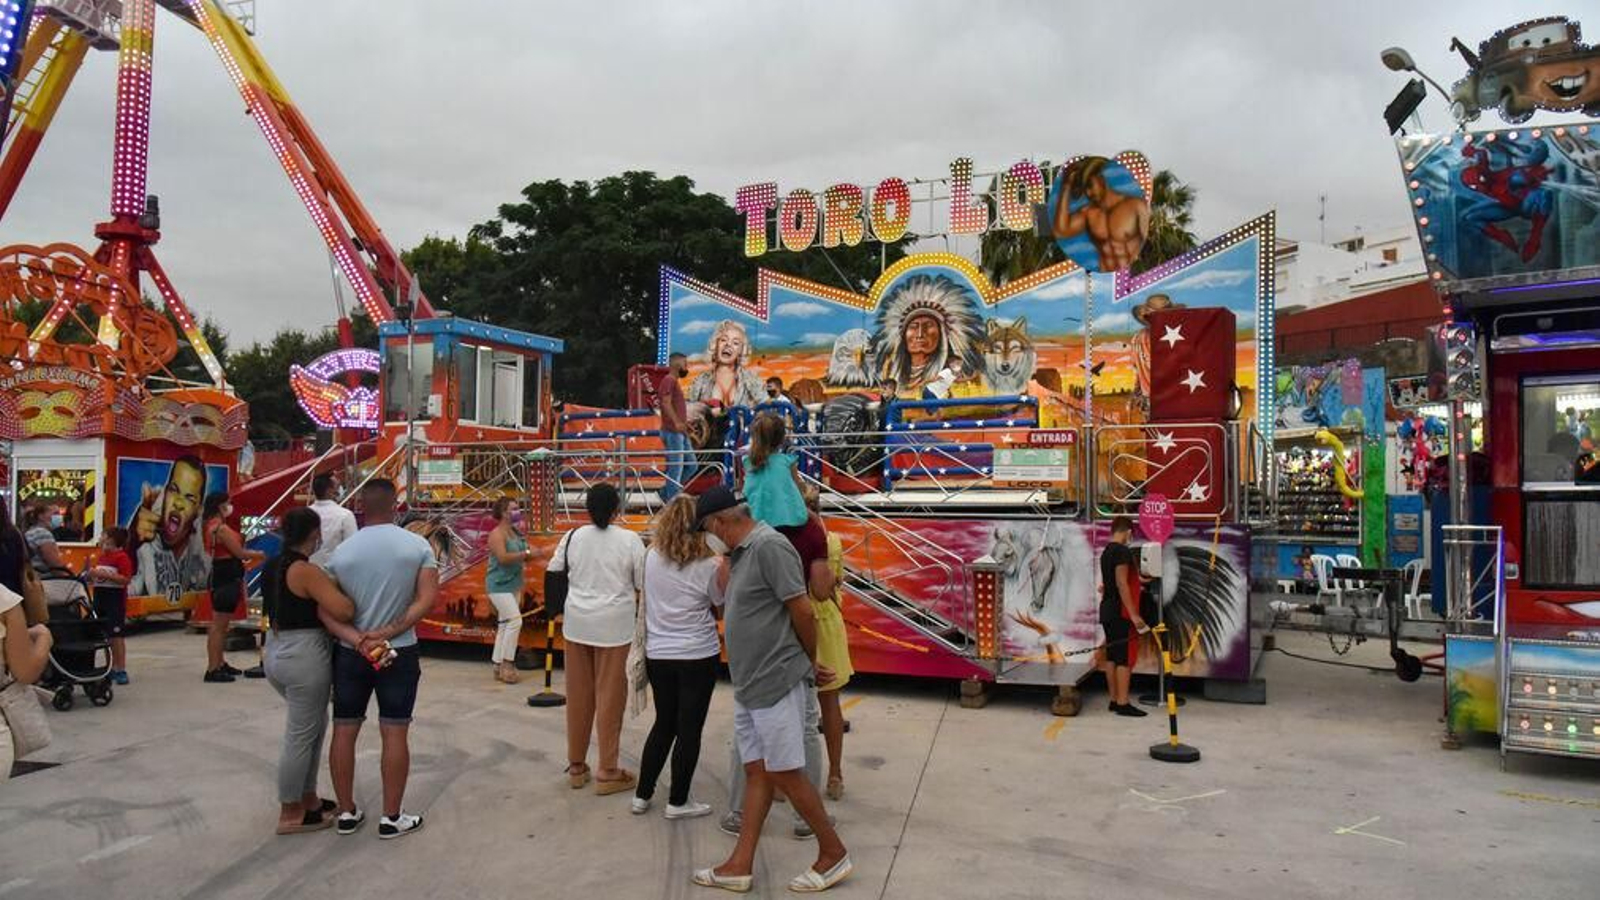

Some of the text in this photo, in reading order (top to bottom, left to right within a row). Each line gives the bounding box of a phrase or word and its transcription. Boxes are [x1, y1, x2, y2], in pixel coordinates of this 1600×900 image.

[735, 151, 1152, 257] TORO LO
[1030, 432, 1074, 443] ENTRADA
[1144, 501, 1167, 514] STOP
[168, 584, 181, 602] 70
